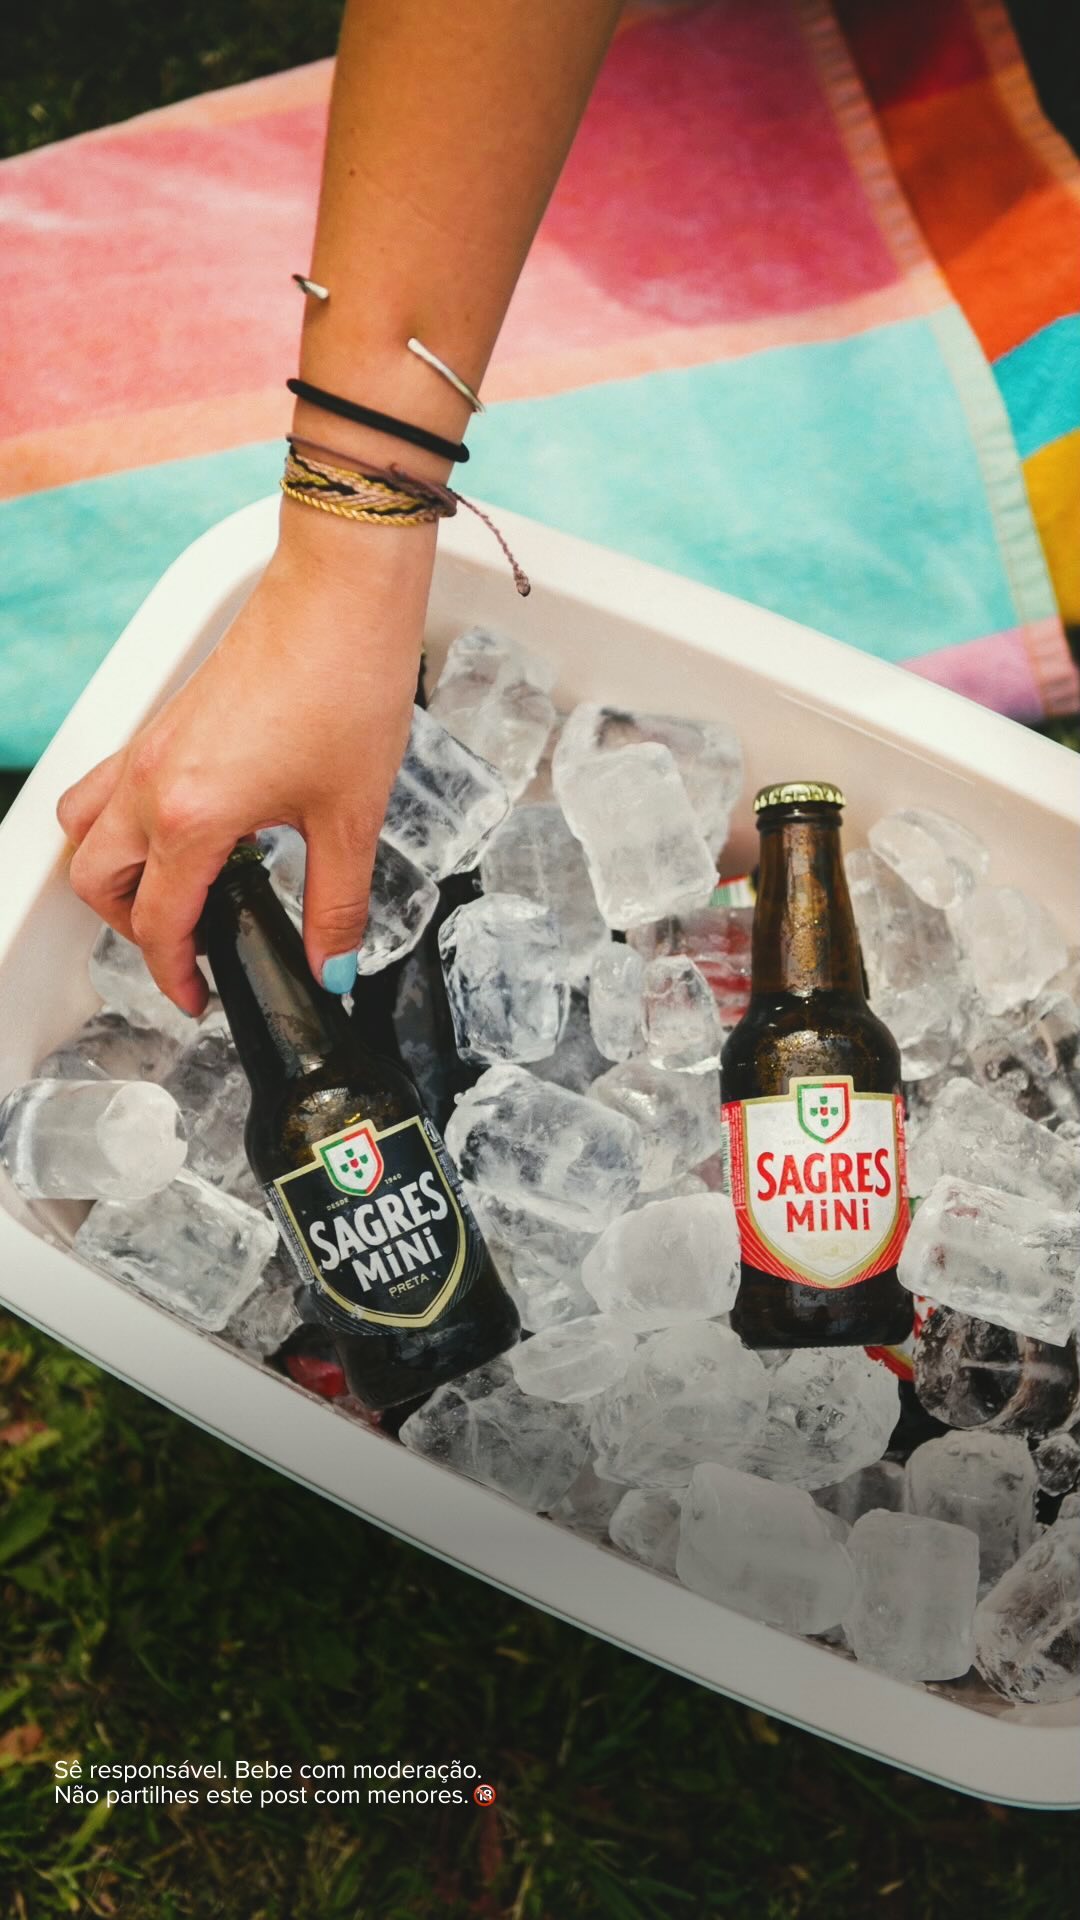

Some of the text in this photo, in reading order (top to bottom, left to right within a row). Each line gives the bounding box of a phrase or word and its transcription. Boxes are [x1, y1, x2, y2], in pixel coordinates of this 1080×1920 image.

[326, 1173, 402, 1211] DESDE 1940
[756, 1147, 892, 1202] SAGRES
[309, 1170, 449, 1271] SAGRES
[388, 1273, 429, 1297] PRETA
